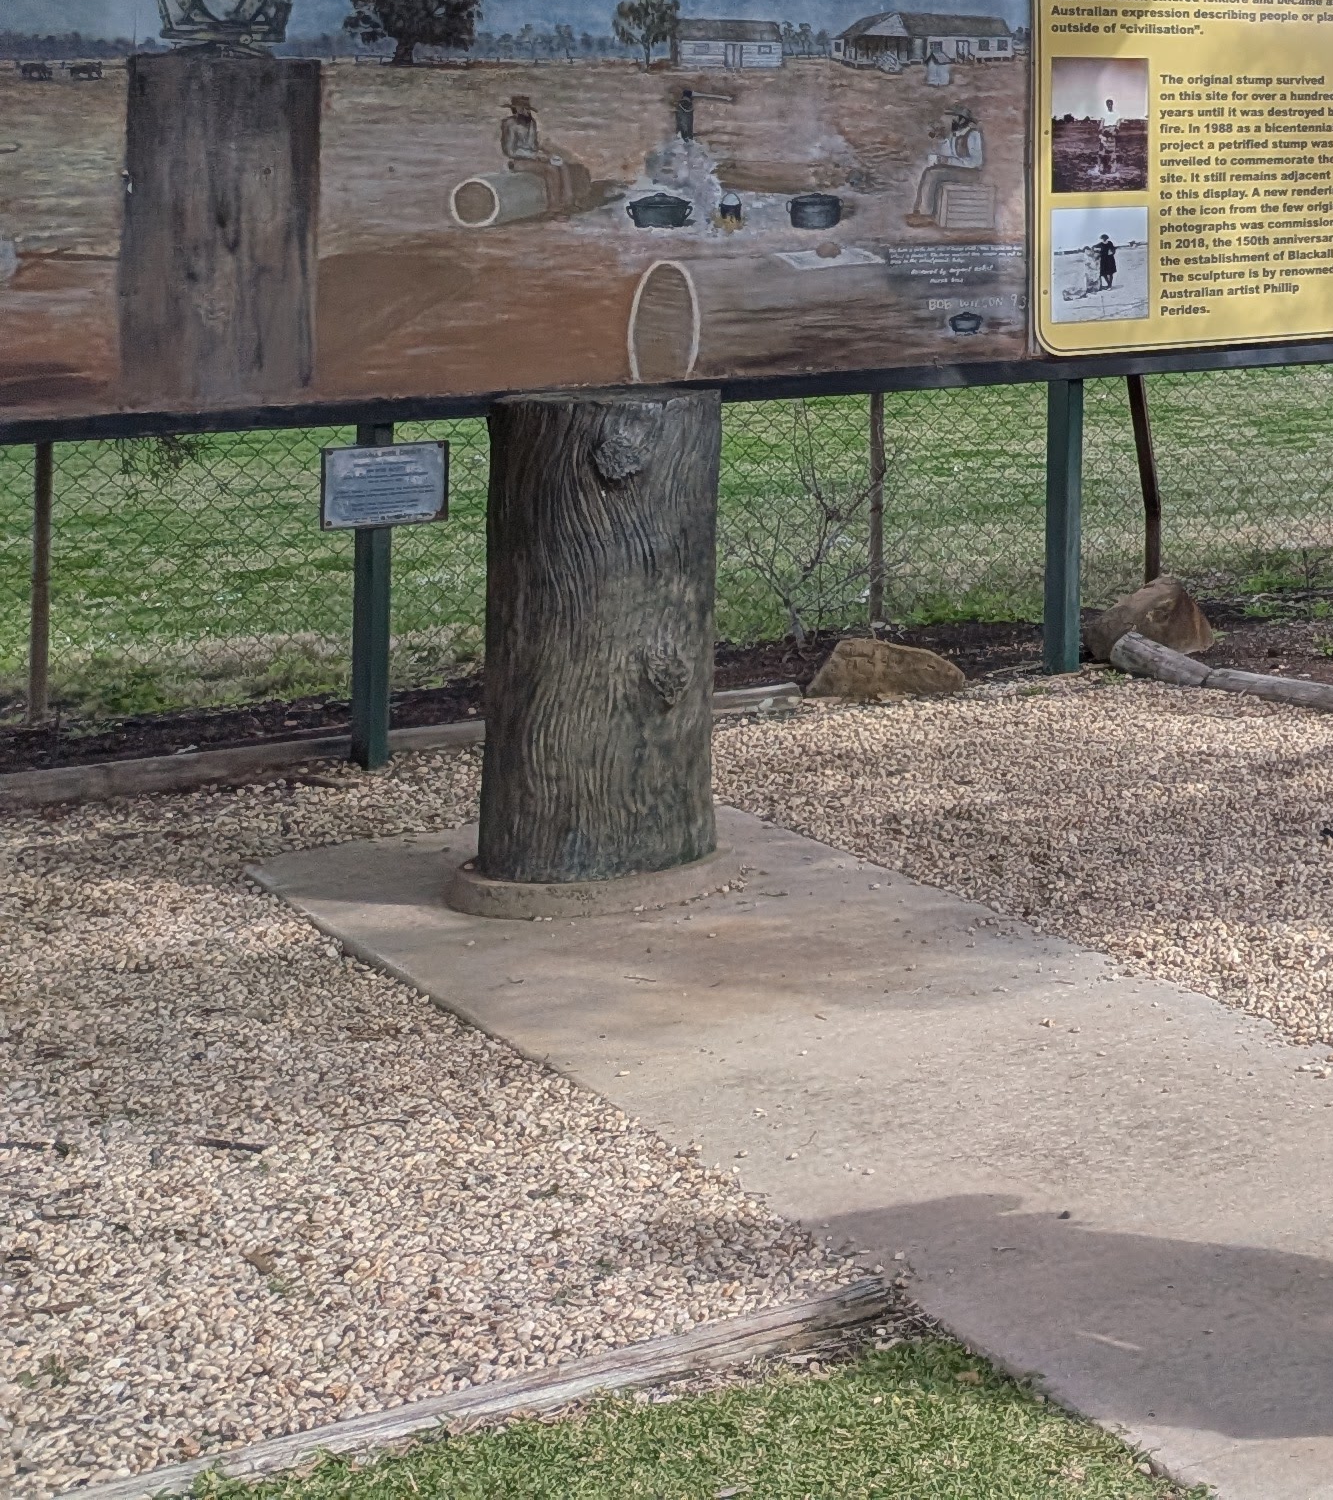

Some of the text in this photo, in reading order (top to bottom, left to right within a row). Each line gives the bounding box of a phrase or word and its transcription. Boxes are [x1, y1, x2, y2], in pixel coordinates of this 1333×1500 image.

[1051, 4, 1118, 17] Australian
[1121, 6, 1190, 21] expression
[1193, 7, 1256, 22] describing
[1260, 9, 1298, 23] people
[1302, 12, 1314, 21] or
[1051, 21, 1099, 33] outside
[1103, 21, 1116, 33] of
[1160, 73, 1325, 87] The original stump survived
[1160, 91, 1175, 101] on
[1179, 89, 1202, 101] this
[1205, 89, 1228, 101] site
[1231, 89, 1248, 101] for
[1251, 91, 1277, 101] over
[1279, 91, 1287, 101] a
[1160, 108, 1194, 119] years
[1197, 105, 1224, 117] until
[1228, 105, 1237, 117] it
[1240, 107, 1264, 117] was
[1267, 105, 1325, 119] destroyed
[1160, 122, 1184, 133] fire.
[1188, 121, 1200, 133] In
[1204, 121, 1233, 133] 1988
[1236, 124, 1251, 133] as
[1254, 123, 1261, 133] a
[1160, 137, 1333, 153] project a petrified stump was
[1160, 154, 1211, 167] unveiled
[1215, 154, 1227, 166] to
[1230, 153, 1315, 166] commemorate
[1160, 168, 1331, 183] site. It still remains adjacent
[1160, 188, 1173, 200] to
[1176, 187, 1199, 199] this
[1203, 186, 1248, 201] display.
[1252, 186, 1260, 198] A
[1264, 187, 1288, 197] new
[1160, 204, 1172, 216] of
[1176, 204, 1196, 216] the
[1200, 203, 1226, 215] icon
[1229, 202, 1257, 214] from
[1260, 201, 1279, 213] the
[1282, 200, 1304, 212] few
[1160, 220, 1237, 235] photographs
[1240, 220, 1264, 230] was
[1160, 237, 1172, 249] in
[1175, 236, 1209, 251] 2018,
[1212, 235, 1232, 247] the
[1236, 233, 1269, 246] 150th
[1160, 254, 1181, 266] the
[1184, 250, 1270, 265] establishment
[1273, 249, 1285, 261] of
[1160, 270, 1184, 282] The
[1188, 267, 1245, 283] sculpture
[1249, 266, 1259, 279] is
[1262, 266, 1276, 280] by
[1160, 280, 1299, 299] Australian artist Phillip
[1161, 302, 1210, 315] Perides.
